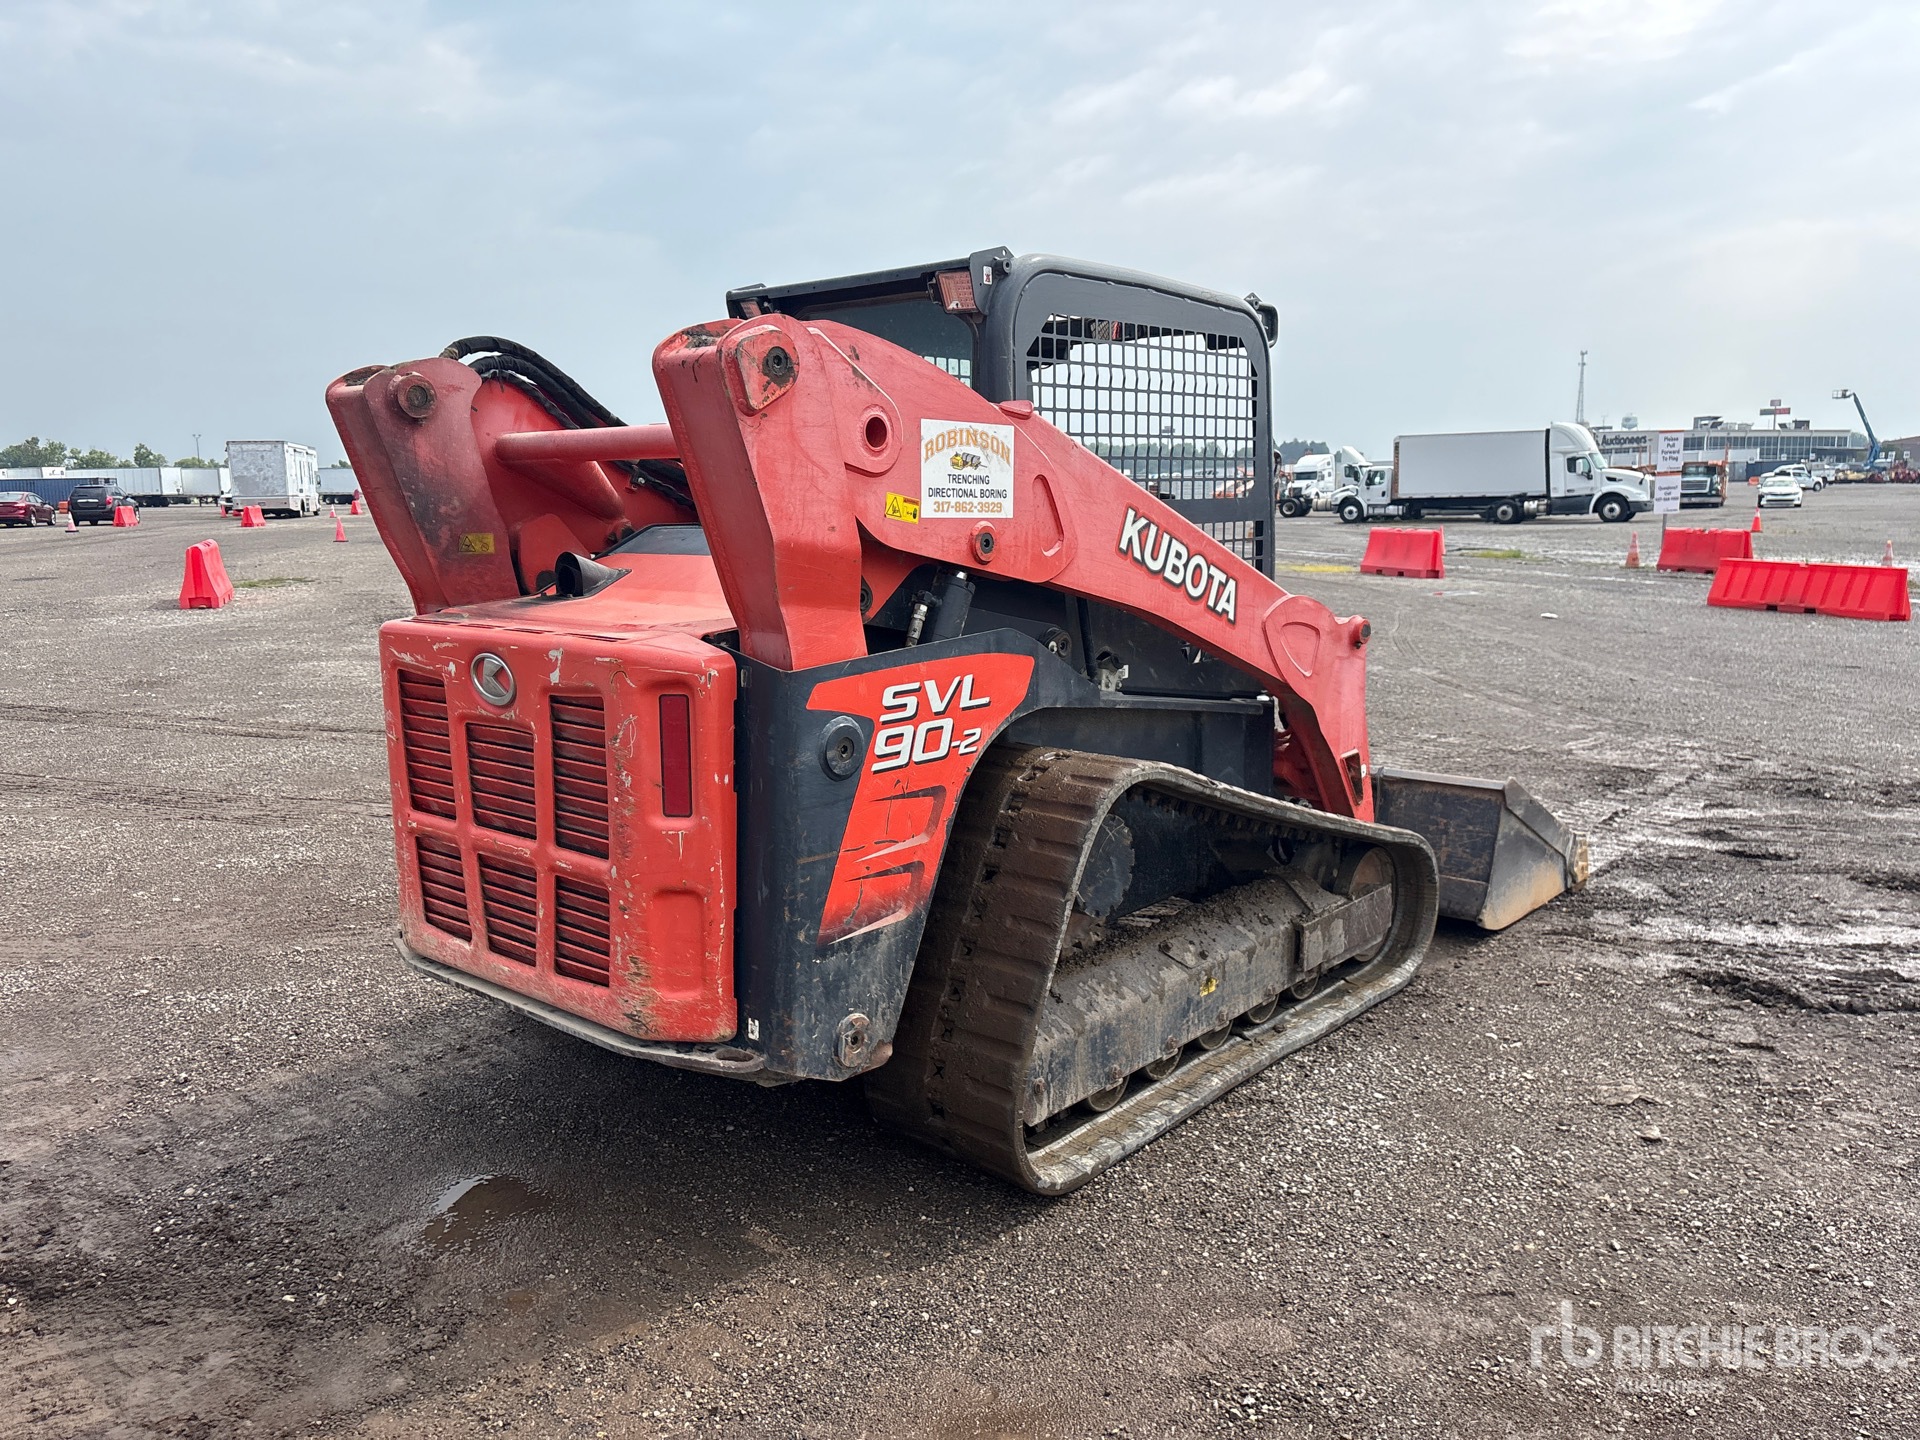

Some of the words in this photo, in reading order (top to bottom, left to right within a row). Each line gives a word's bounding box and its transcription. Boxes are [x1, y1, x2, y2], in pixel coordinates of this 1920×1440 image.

[924, 427, 1011, 467] ROBINSON
[1601, 434, 1647, 446] Auctioneers
[947, 473, 990, 485] TRENCHING
[928, 487, 978, 498] DIRECTIONAL
[979, 488, 1008, 499] BORING
[933, 501, 1003, 513] 317-862-3929
[1118, 506, 1238, 625] KUBOTA
[879, 674, 991, 725] SVL
[870, 717, 982, 774] 90-2
